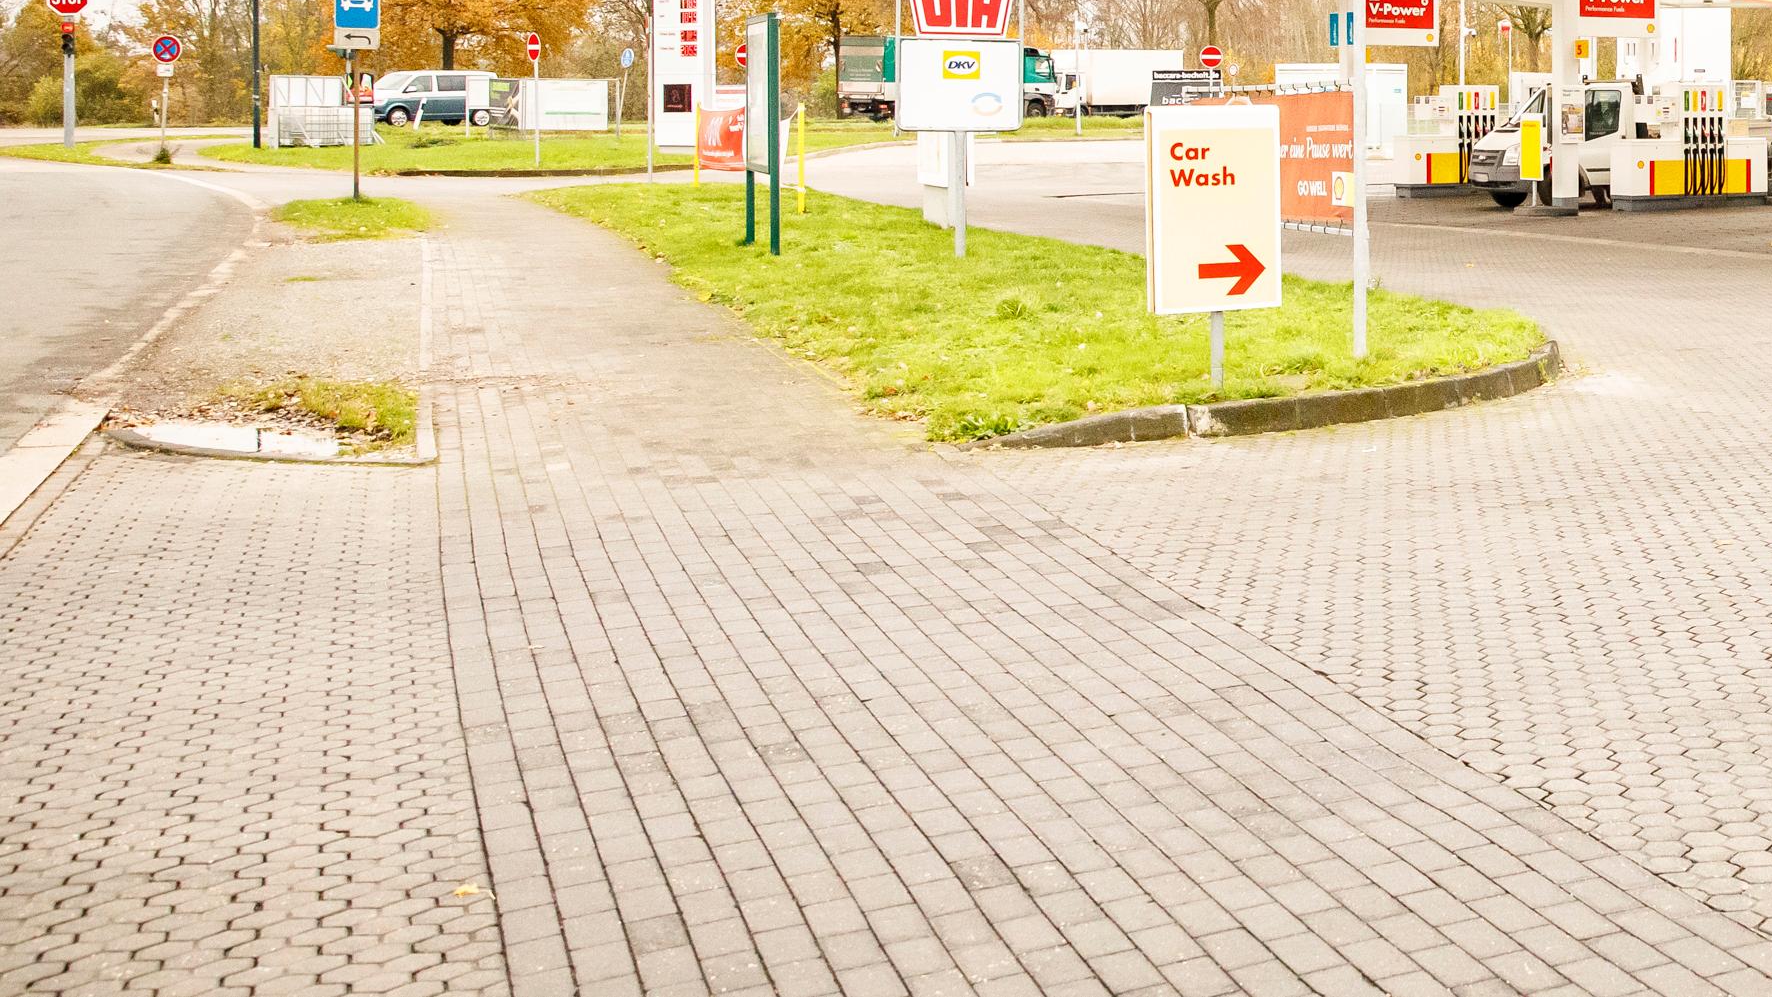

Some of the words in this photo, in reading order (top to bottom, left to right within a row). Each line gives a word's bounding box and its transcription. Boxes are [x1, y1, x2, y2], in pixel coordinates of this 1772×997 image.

[1368, 2, 1426, 17] V-Power
[1576, 44, 1583, 56] 5
[947, 60, 976, 70] DKV
[1170, 142, 1210, 161] Car
[1289, 136, 1305, 159] eine
[1305, 136, 1330, 159] Pause
[1331, 139, 1353, 160] wert
[1169, 165, 1236, 187] Wash
[1297, 180, 1309, 196] GO
[1309, 180, 1328, 196] WELL
